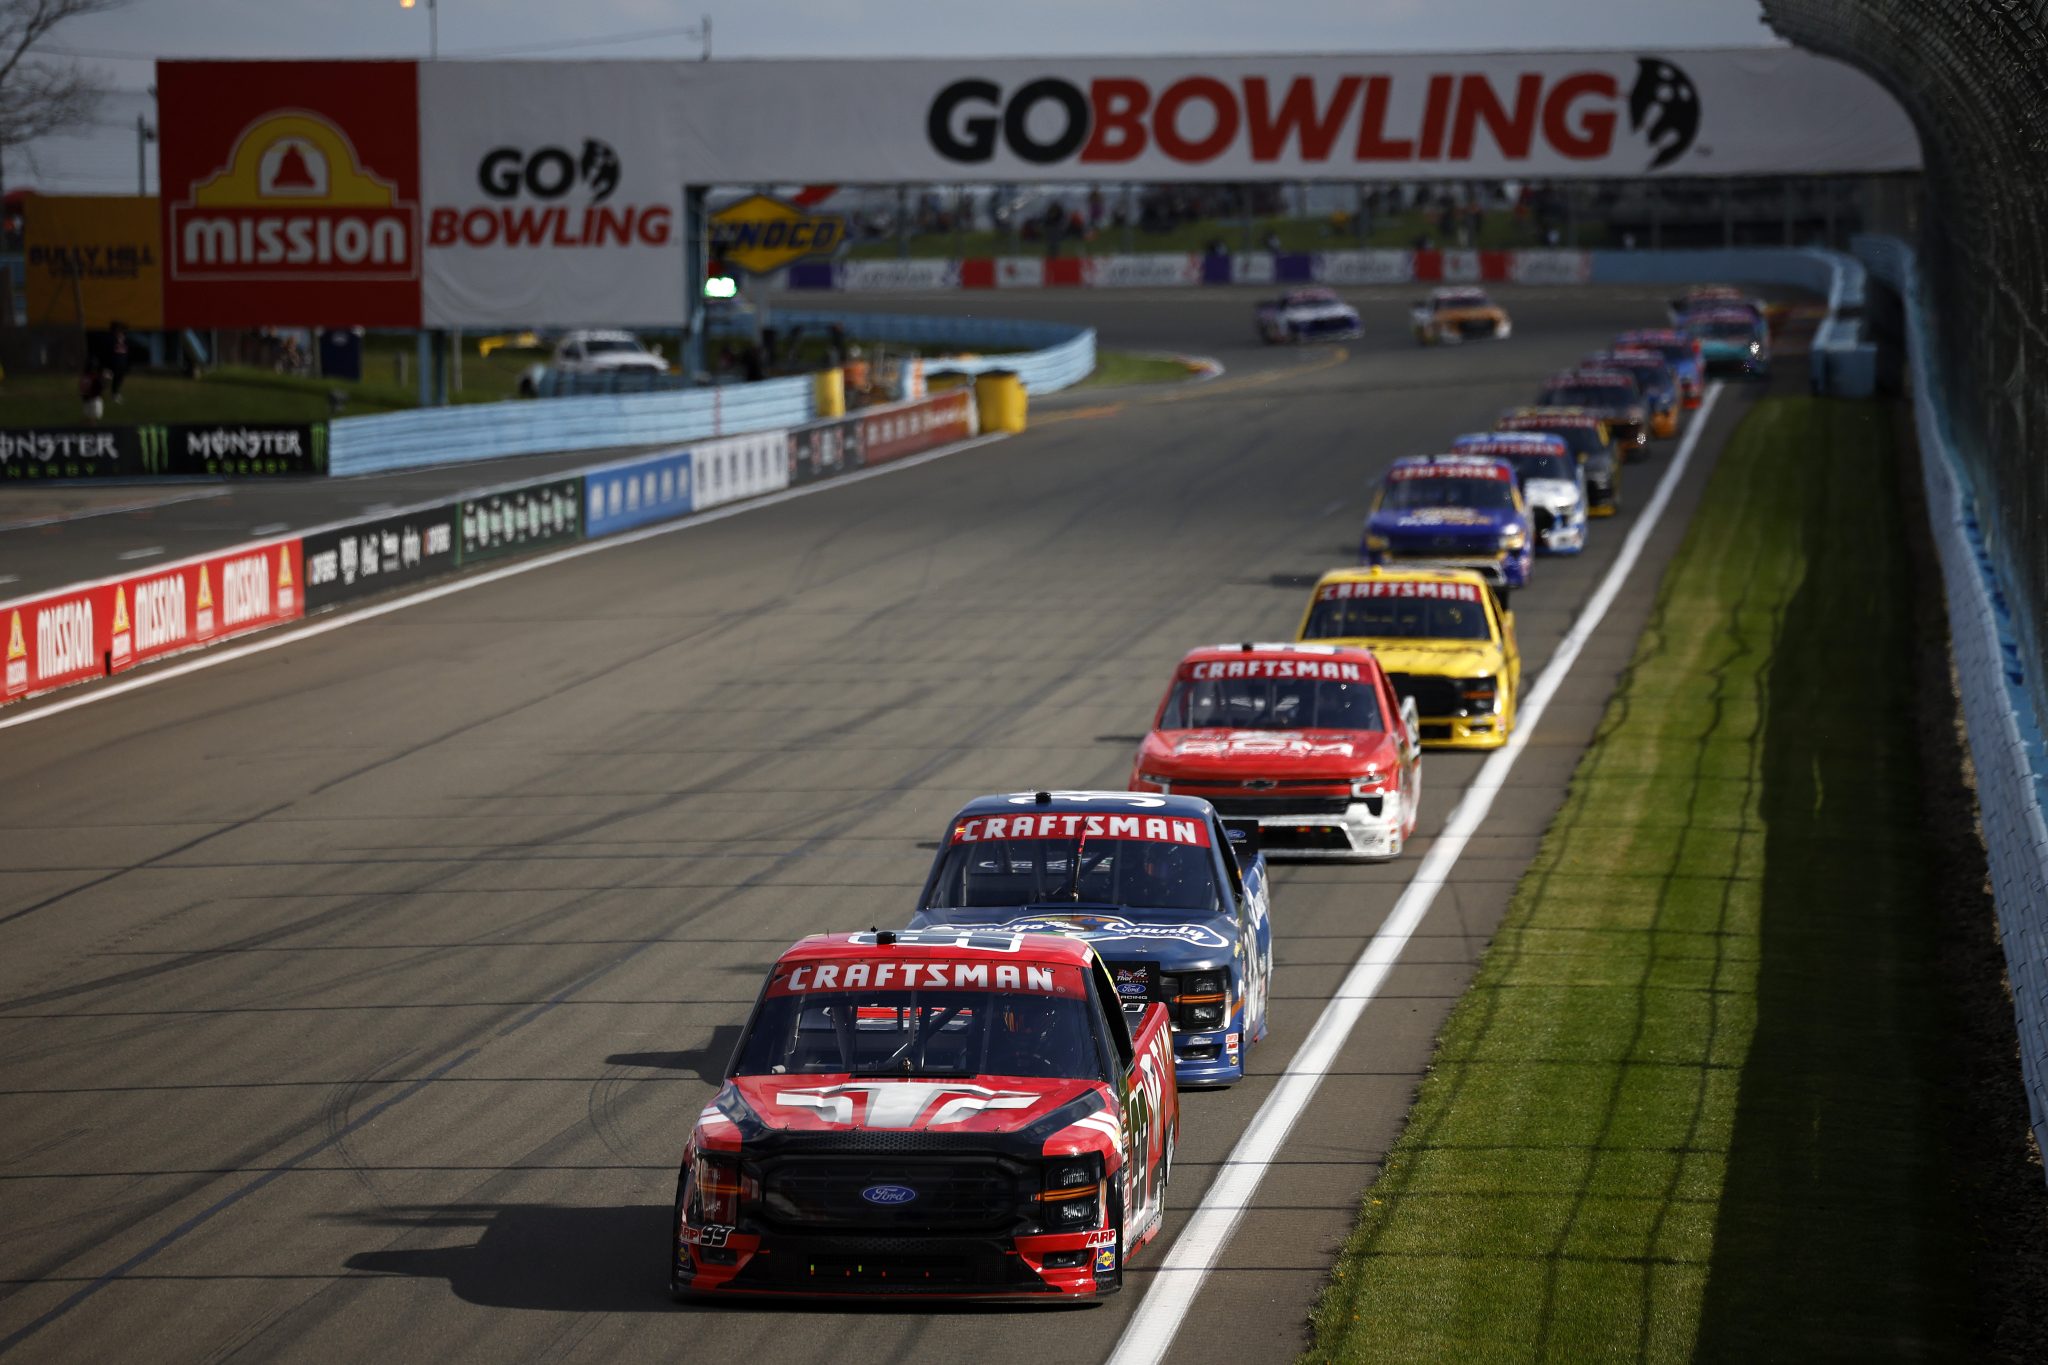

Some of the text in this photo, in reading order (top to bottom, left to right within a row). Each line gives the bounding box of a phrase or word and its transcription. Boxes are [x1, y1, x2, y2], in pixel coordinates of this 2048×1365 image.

[478, 146, 576, 200] GO
[184, 217, 406, 265] MISSION
[428, 206, 672, 248] BOWLING
[0, 430, 118, 463] ONSTER
[186, 427, 303, 460] MONSTER
[6, 463, 97, 479] NERGY
[223, 552, 271, 627] MISSION
[1322, 582, 1476, 601] CRAFTSMAN
[134, 572, 187, 652] MISSION
[37, 597, 95, 681] MISSION
[1192, 661, 1361, 681] CRAFTSMAN
[962, 815, 1198, 844] CRAFTSMAN
[1103, 922, 1210, 942] County
[787, 963, 1054, 992] CRAFTSMAN
[700, 1224, 736, 1247] 99
[1089, 1231, 1115, 1244] ARP
